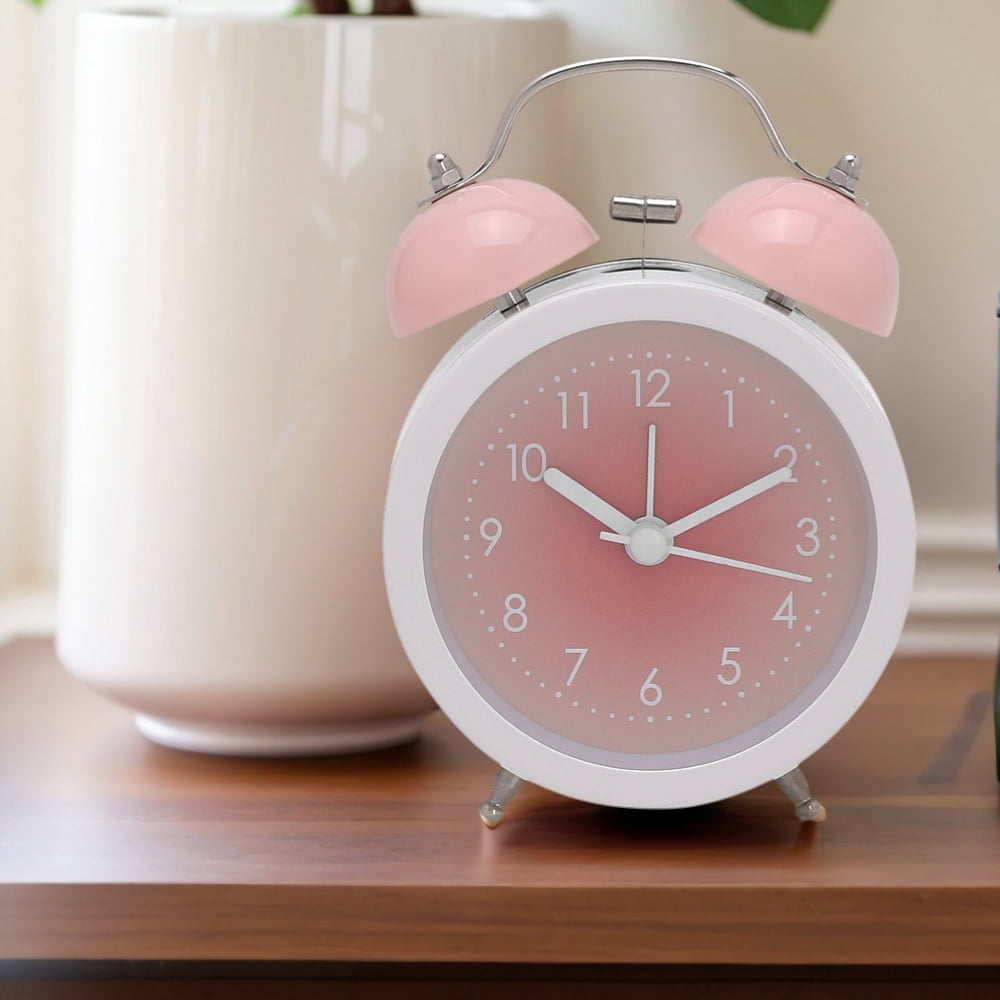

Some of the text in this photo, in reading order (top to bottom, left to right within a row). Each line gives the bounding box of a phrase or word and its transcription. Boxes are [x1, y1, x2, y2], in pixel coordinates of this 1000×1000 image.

[630, 368, 671, 408] 12
[557, 391, 589, 429] 11
[722, 390, 734, 428] 1
[505, 442, 547, 482] 10
[772, 444, 798, 483] 2
[479, 517, 503, 557] 9
[795, 517, 821, 557] 3
[502, 593, 528, 633] 8
[771, 591, 797, 629] 4
[564, 648, 589, 687] 7
[716, 646, 742, 686] 5
[638, 667, 663, 707] 6
